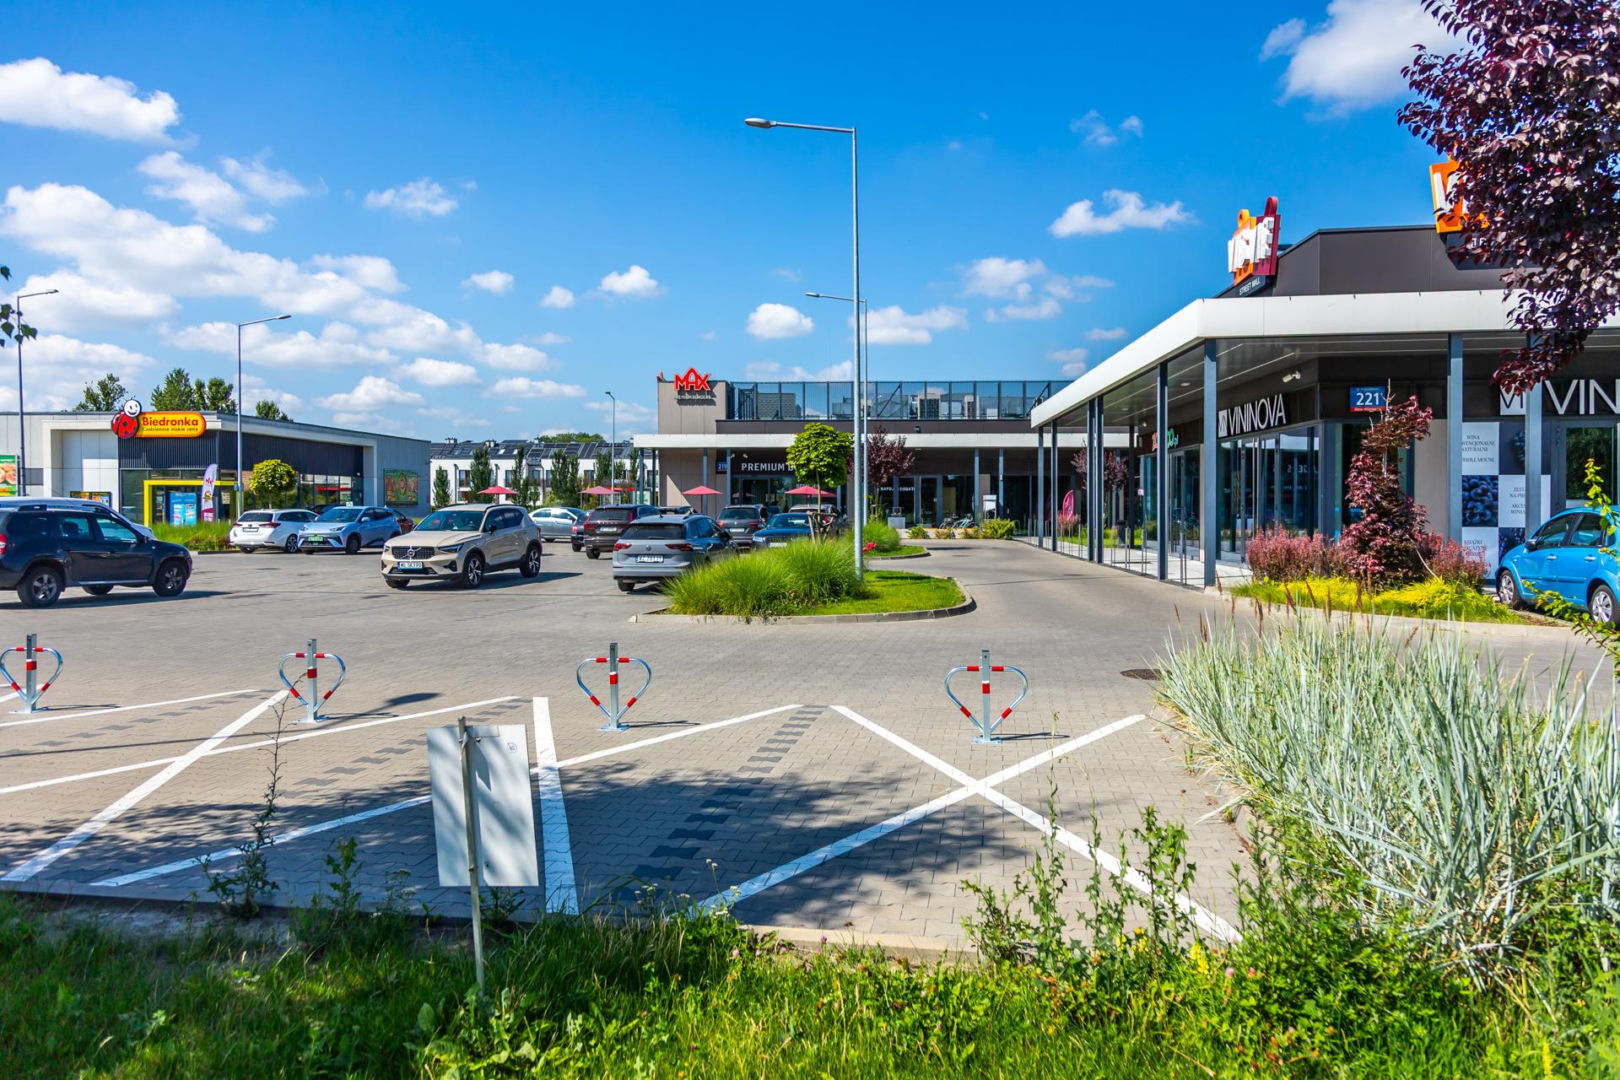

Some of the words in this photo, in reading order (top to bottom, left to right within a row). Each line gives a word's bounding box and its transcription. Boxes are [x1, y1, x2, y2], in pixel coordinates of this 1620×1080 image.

[674, 367, 711, 391] MAX
[142, 417, 198, 426] Biedronka
[1228, 394, 1286, 435] VININOVA
[741, 462, 785, 471] PREMIUM
